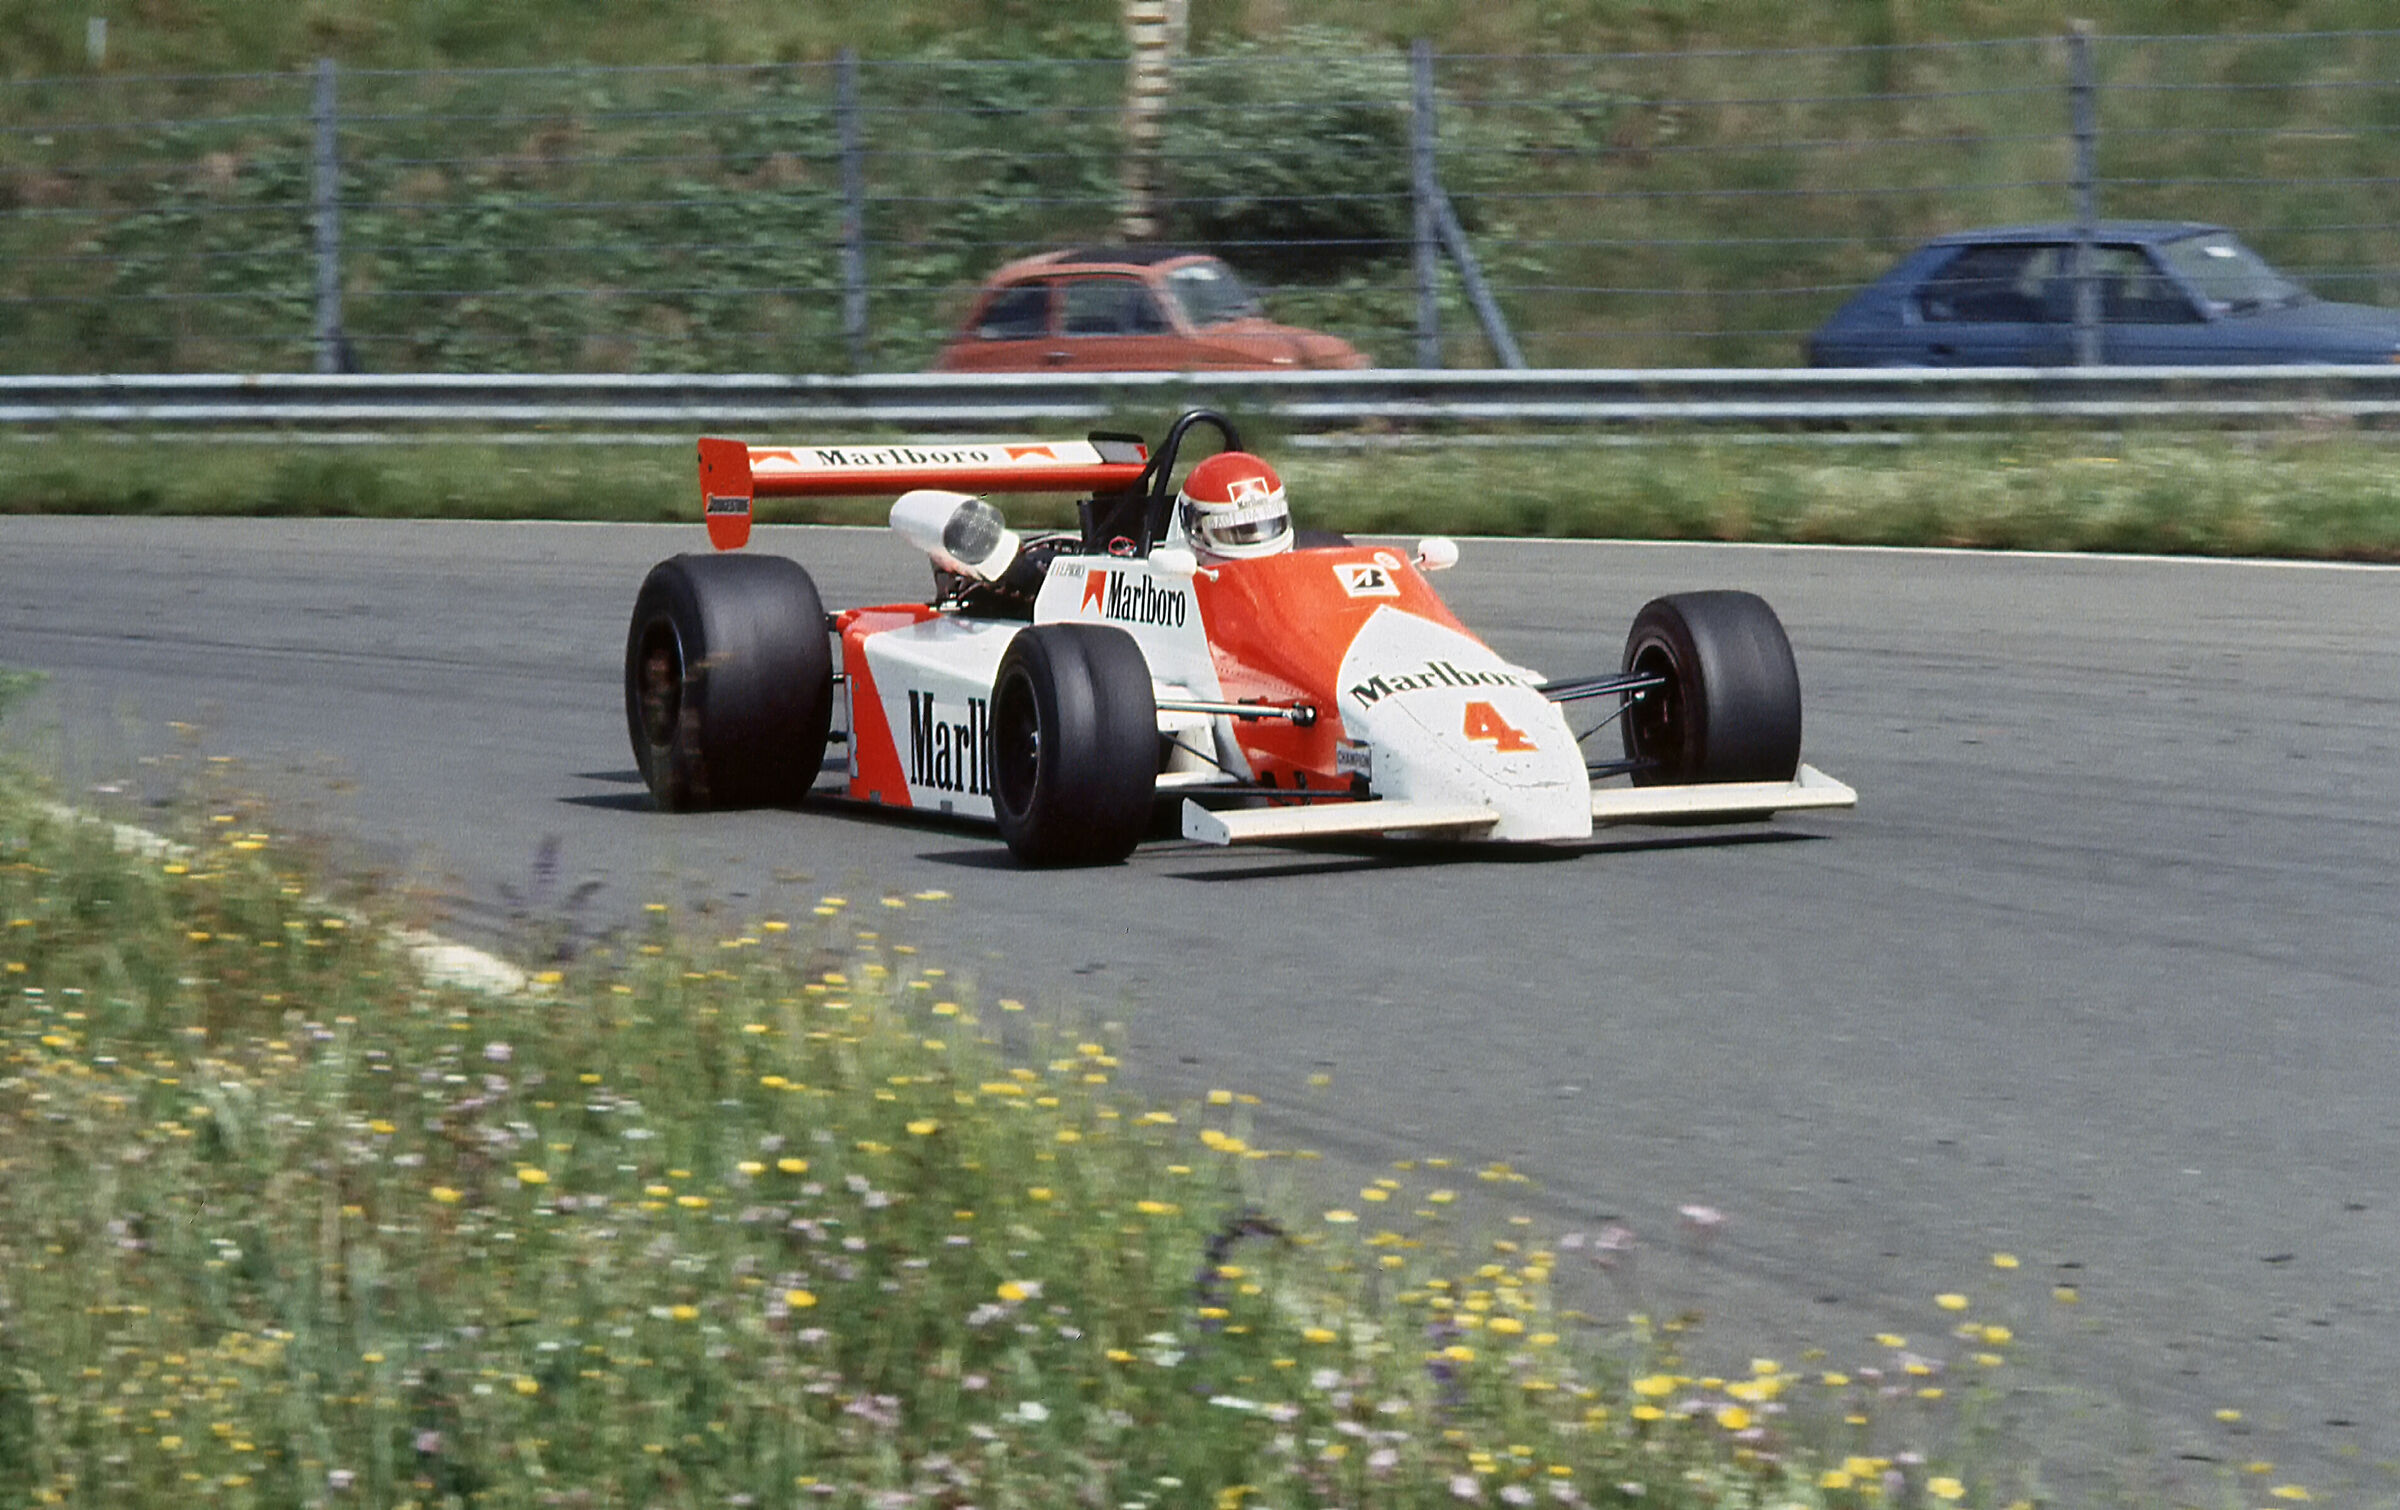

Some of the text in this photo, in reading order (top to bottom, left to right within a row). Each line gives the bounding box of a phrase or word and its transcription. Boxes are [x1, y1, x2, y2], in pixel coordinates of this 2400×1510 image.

[815, 449, 989, 466] Marlboro
[1106, 571, 1186, 628] Marlboro
[1349, 661, 1529, 711] Marlbor
[908, 690, 993, 797] Marlb
[1463, 702, 1538, 753] 4
